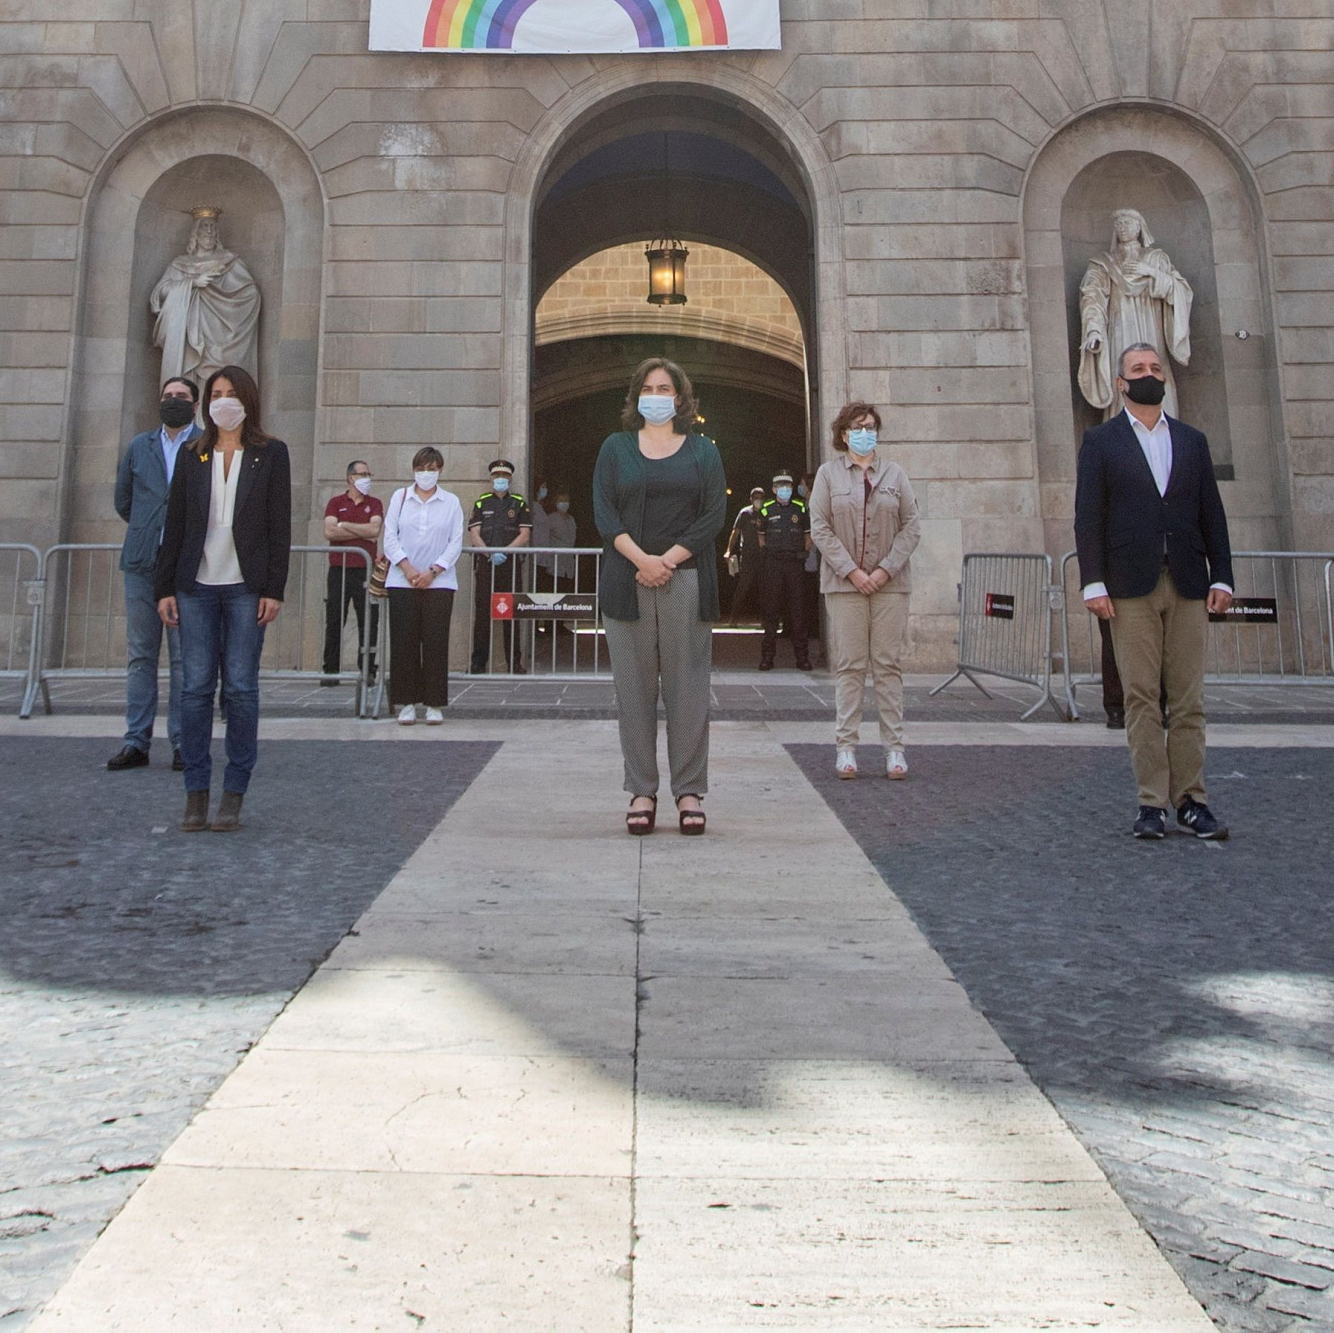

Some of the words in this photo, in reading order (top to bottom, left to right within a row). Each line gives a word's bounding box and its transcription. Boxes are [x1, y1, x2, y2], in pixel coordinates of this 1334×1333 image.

[517, 603, 554, 612] Ajuntament
[554, 603, 562, 611] de
[563, 603, 593, 611] Barcelona
[1235, 606, 1243, 614] de
[1244, 606, 1273, 614] Barcelona
